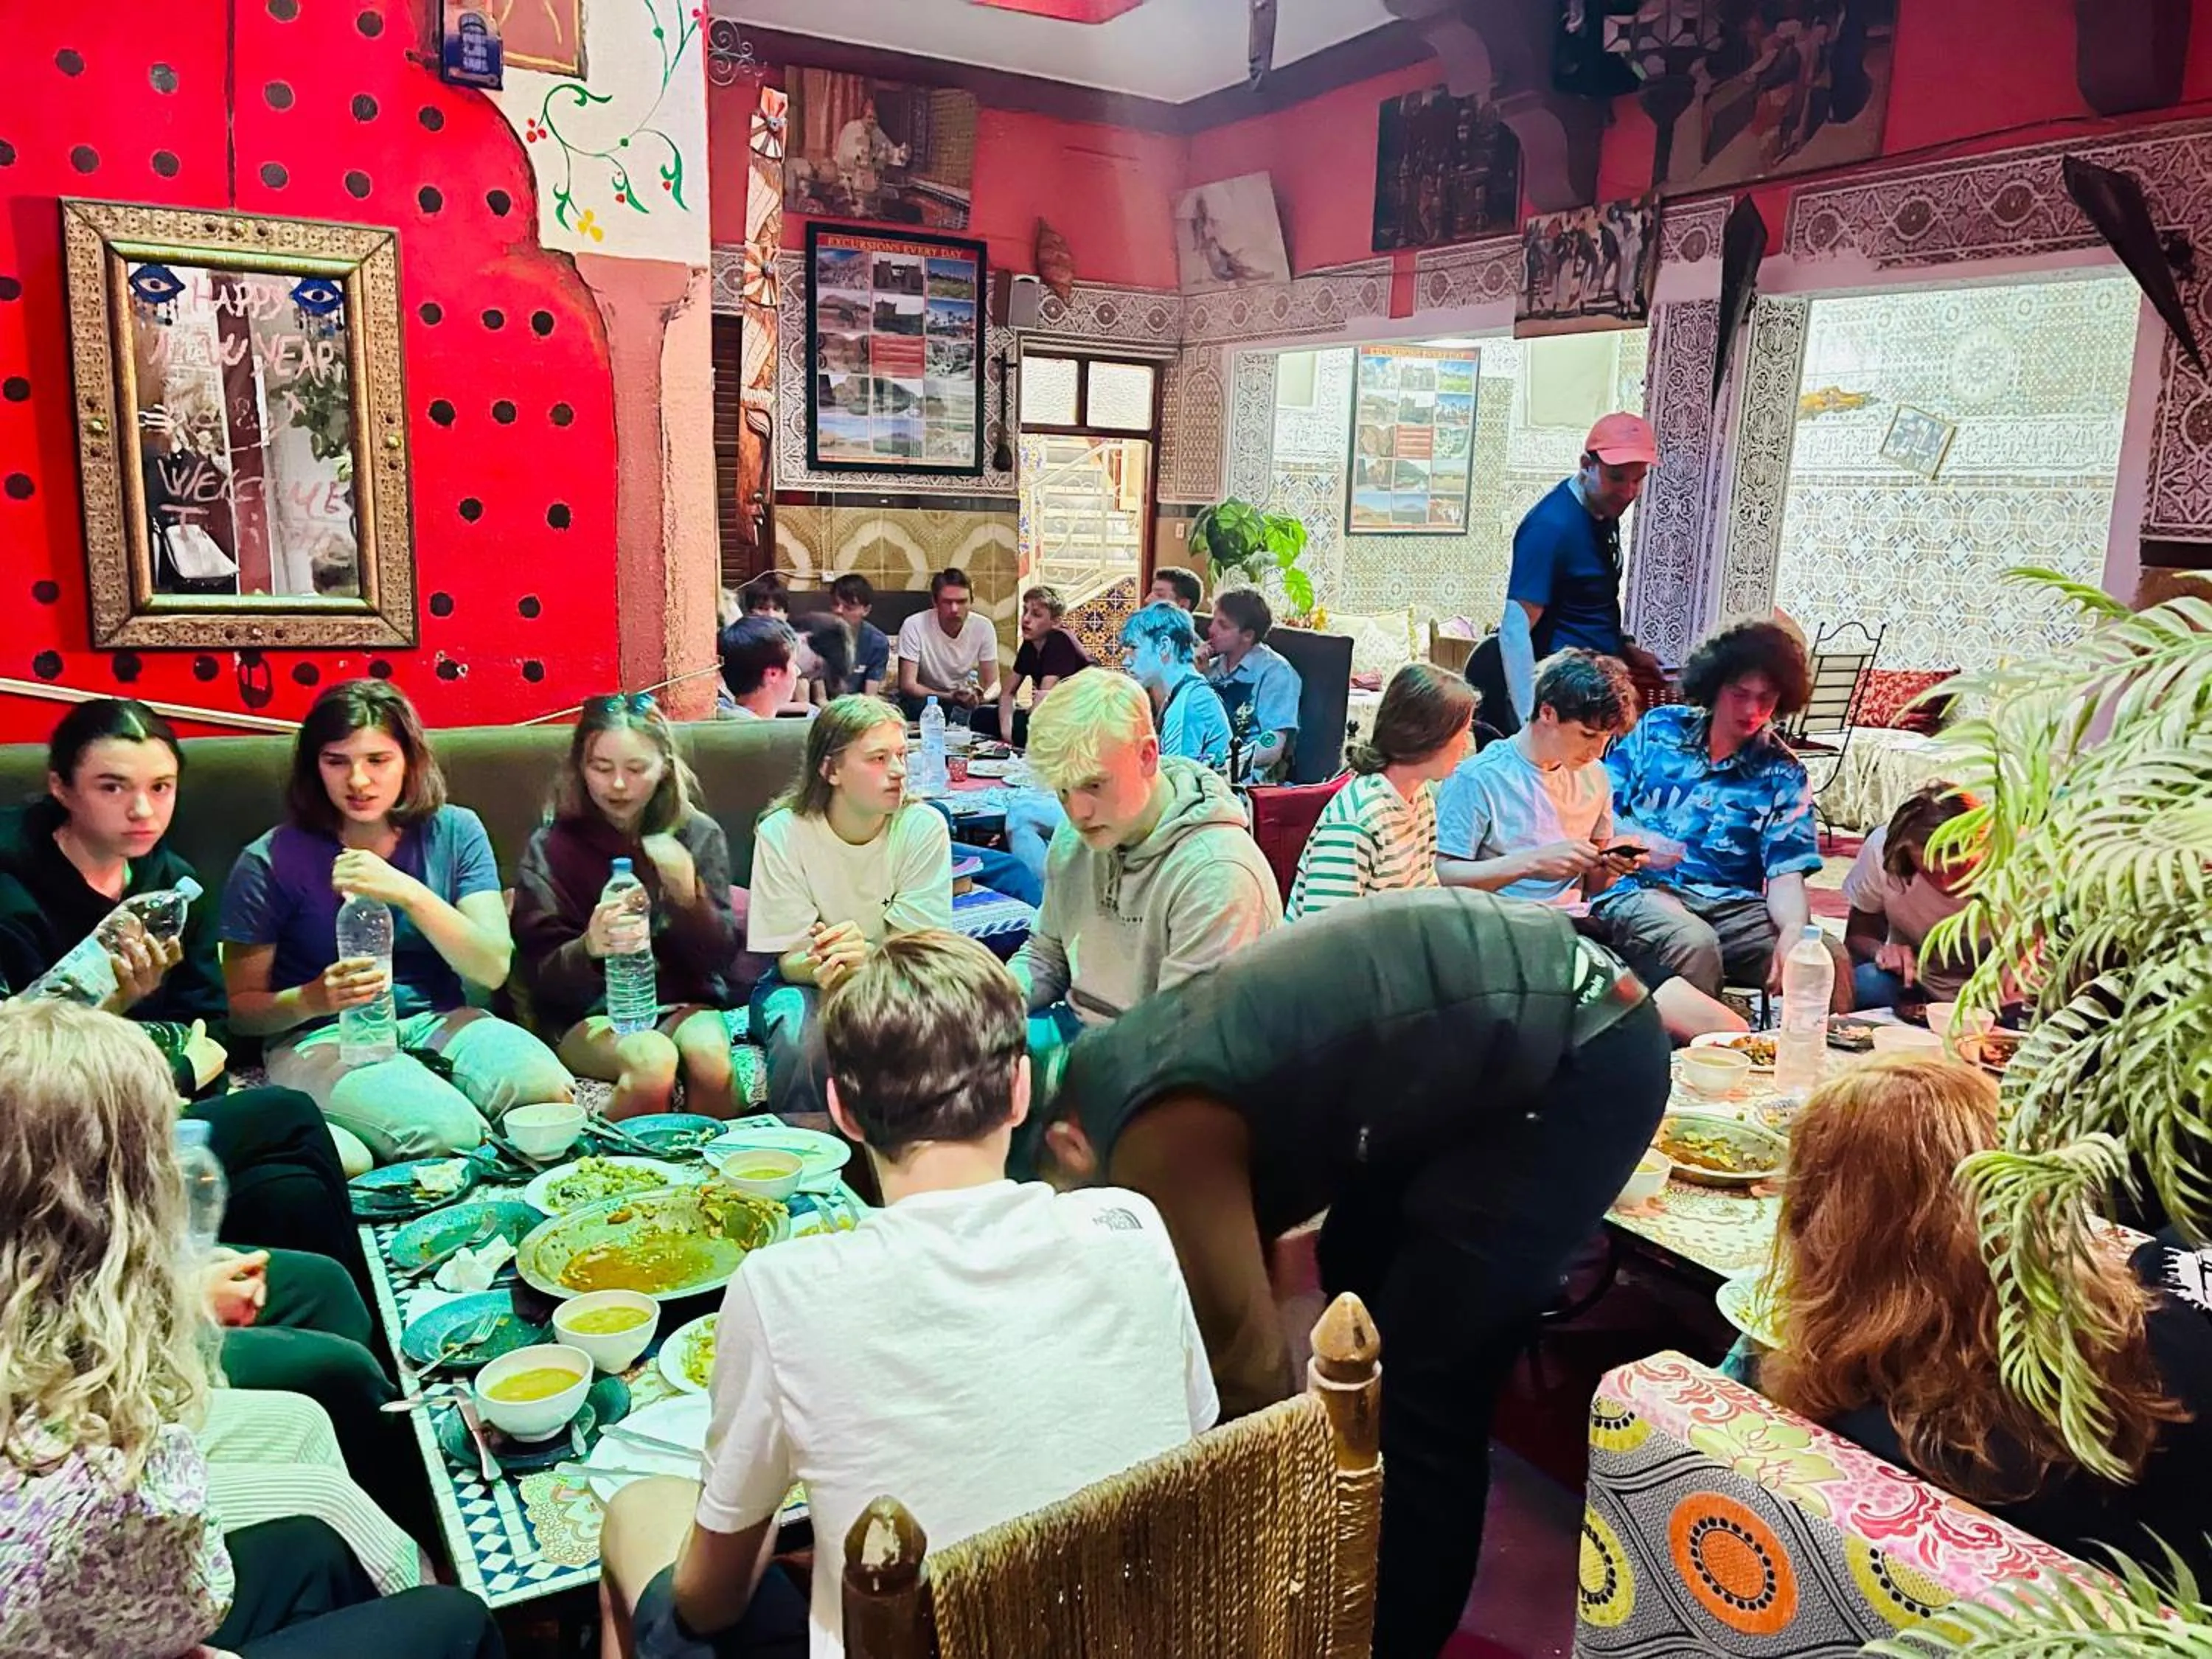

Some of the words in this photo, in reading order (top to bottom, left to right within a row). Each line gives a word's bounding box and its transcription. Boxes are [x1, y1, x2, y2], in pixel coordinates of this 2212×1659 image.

[827, 236, 900, 253] EXCURSIONS
[903, 243, 937, 257] EVERY
[941, 248, 963, 259] DAY
[192, 276, 287, 321] HAPPY
[250, 333, 333, 389] YEAR
[156, 457, 338, 517] WELCME
